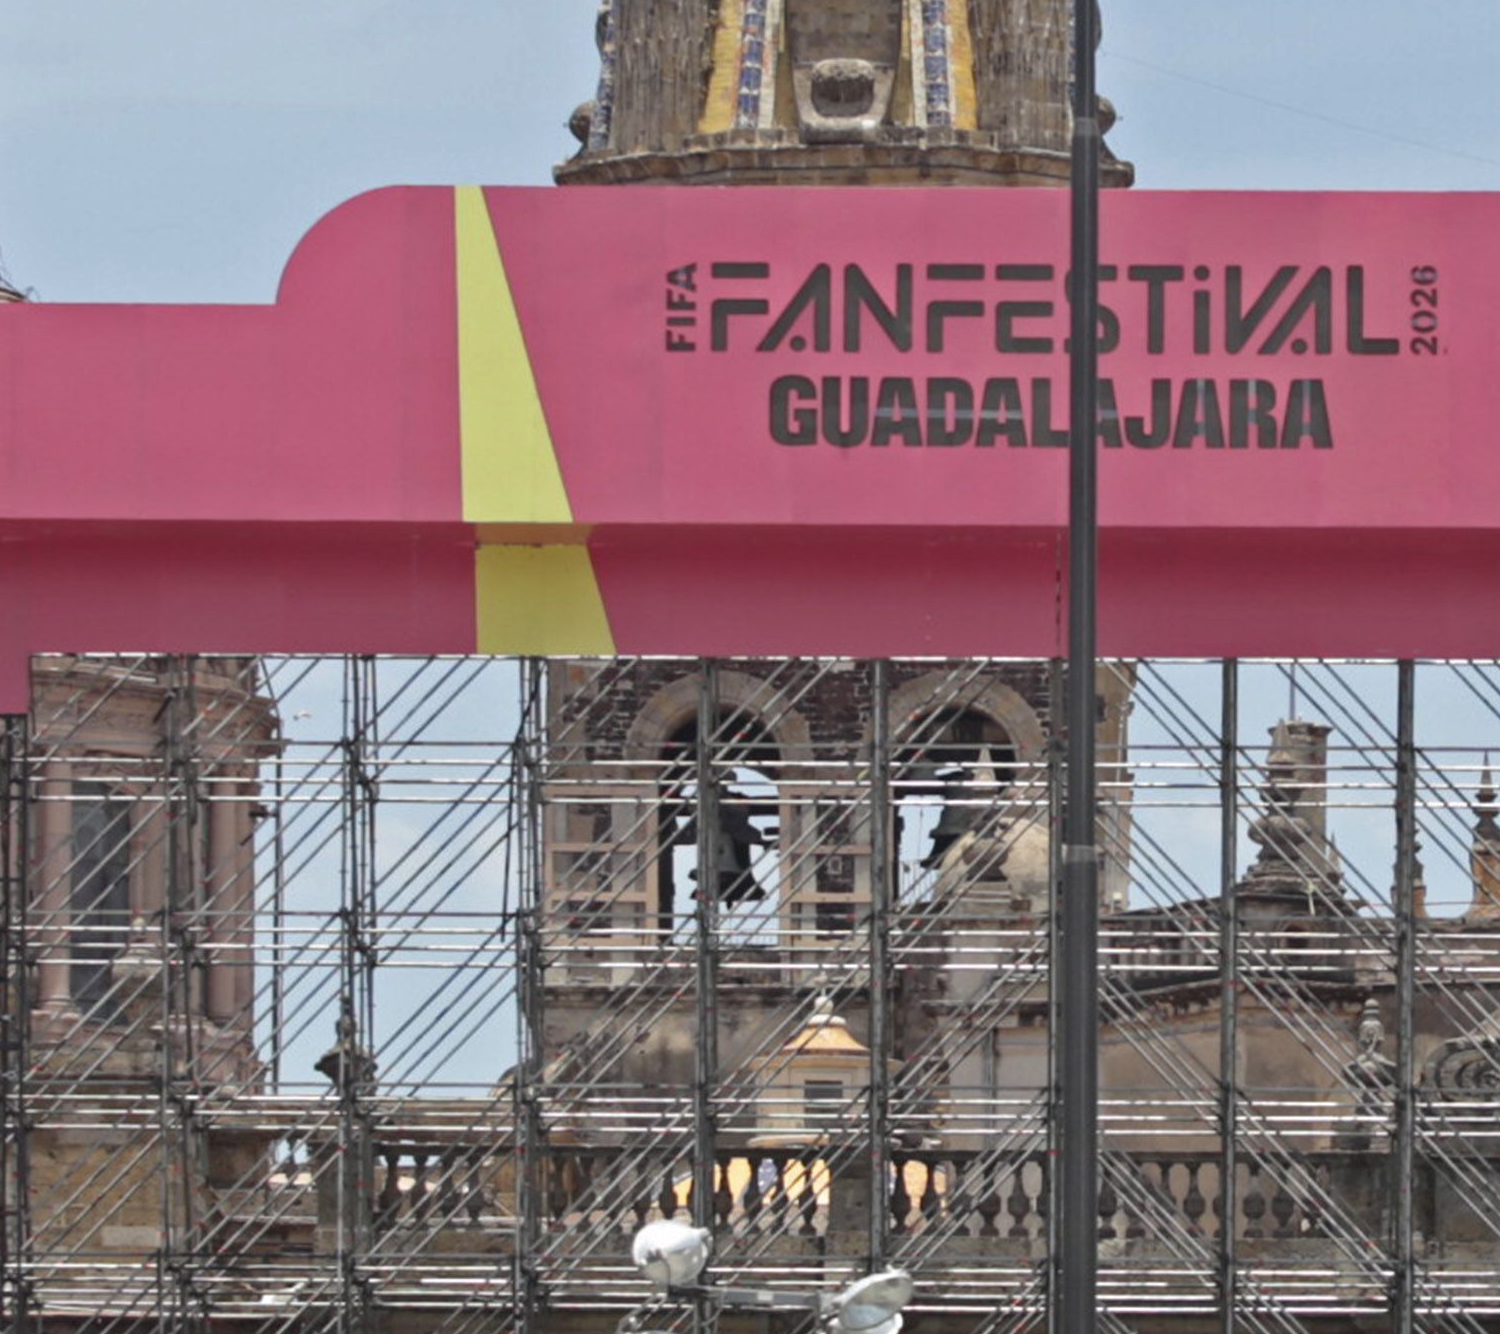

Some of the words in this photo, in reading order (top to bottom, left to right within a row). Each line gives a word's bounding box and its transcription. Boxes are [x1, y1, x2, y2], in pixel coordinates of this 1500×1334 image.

[665, 262, 697, 352] FIFA
[1410, 264, 1438, 355] 2026
[769, 374, 1334, 449] GUADALAJARA
